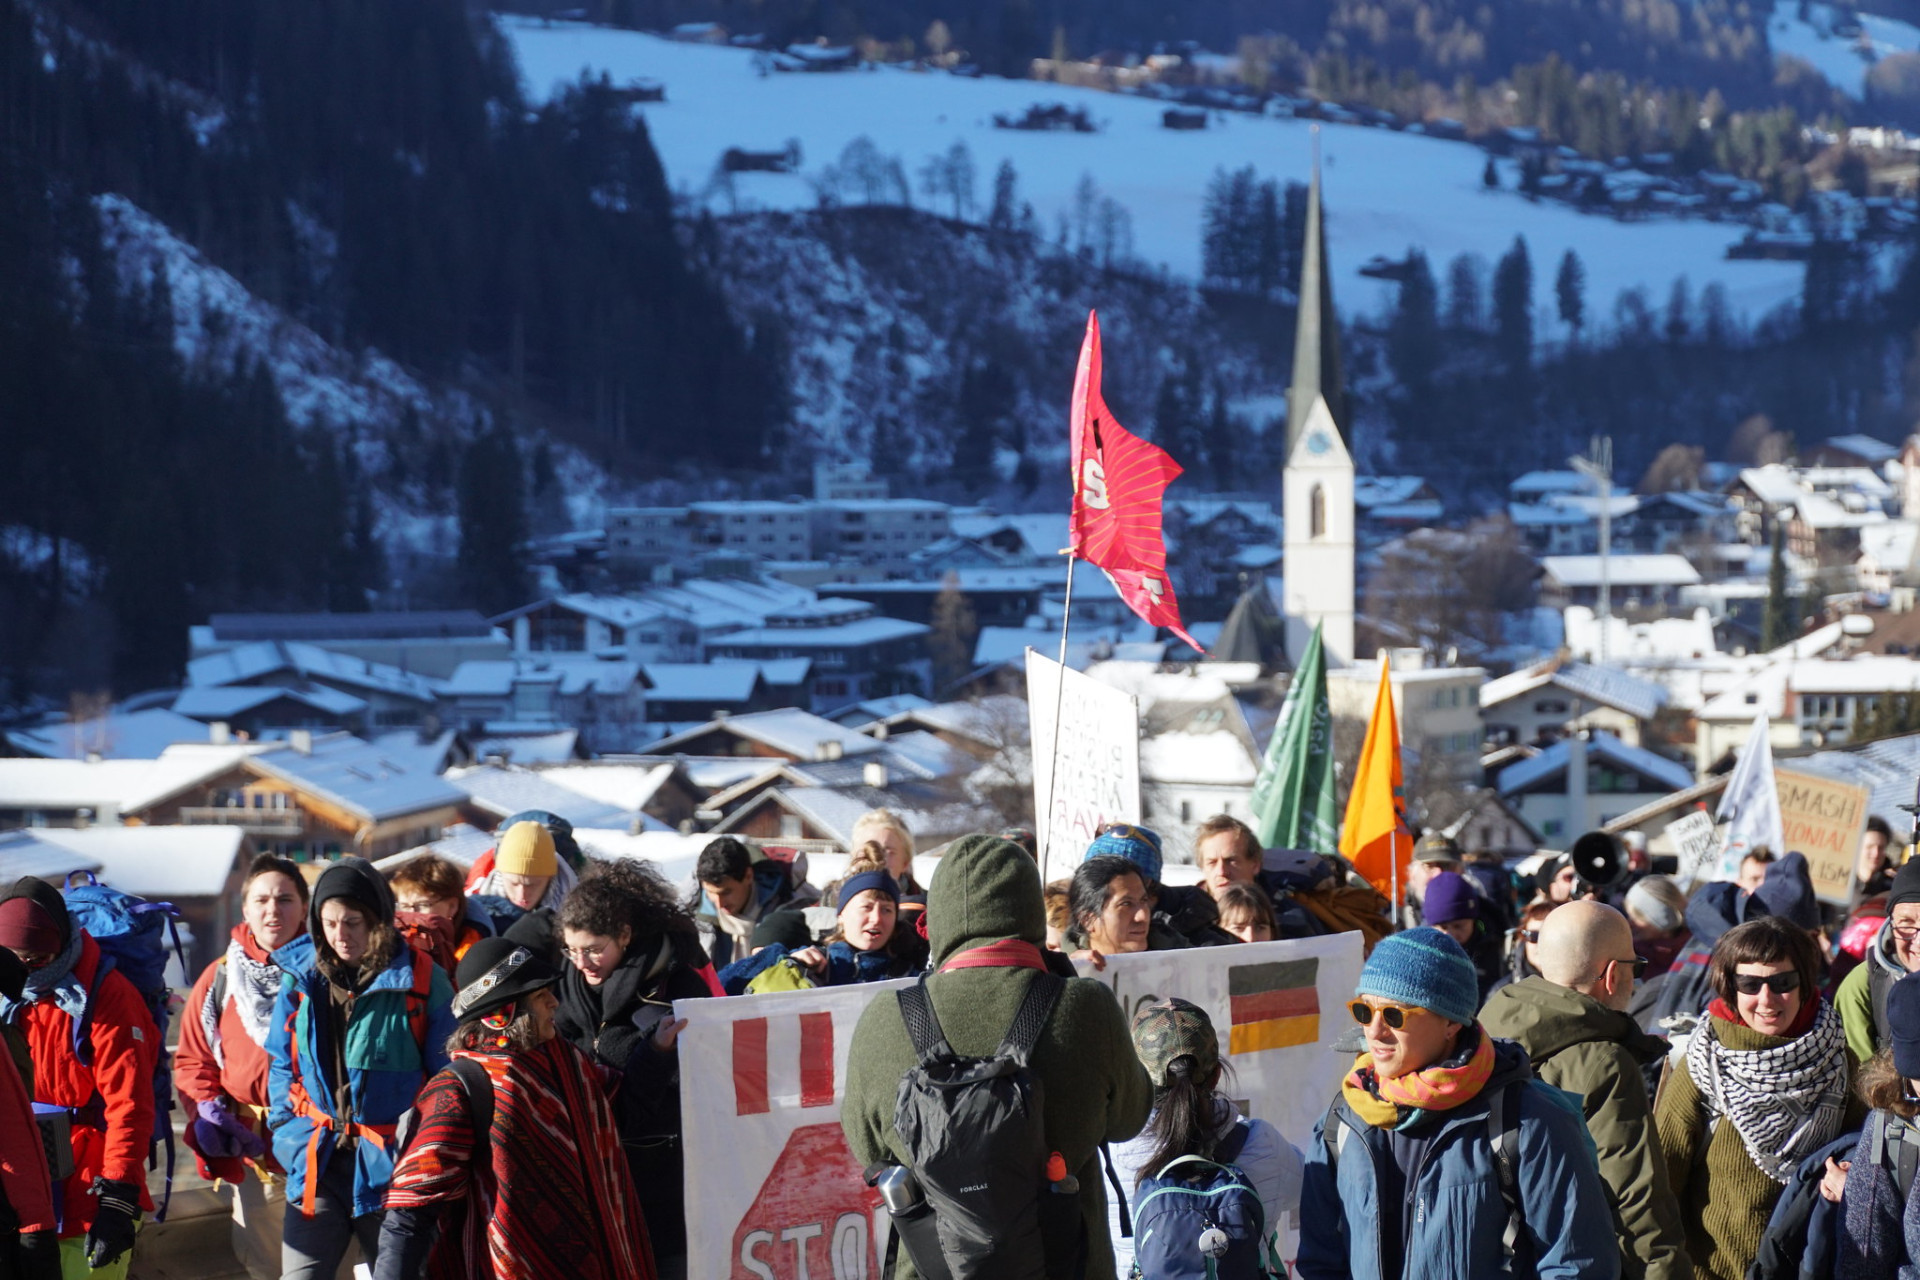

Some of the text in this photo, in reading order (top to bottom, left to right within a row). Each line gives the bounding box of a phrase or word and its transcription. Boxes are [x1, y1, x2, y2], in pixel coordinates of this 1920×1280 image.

[1311, 697, 1331, 755] PSYC
[1777, 781, 1858, 824] SMASH
[1782, 817, 1847, 852] LONIAL
